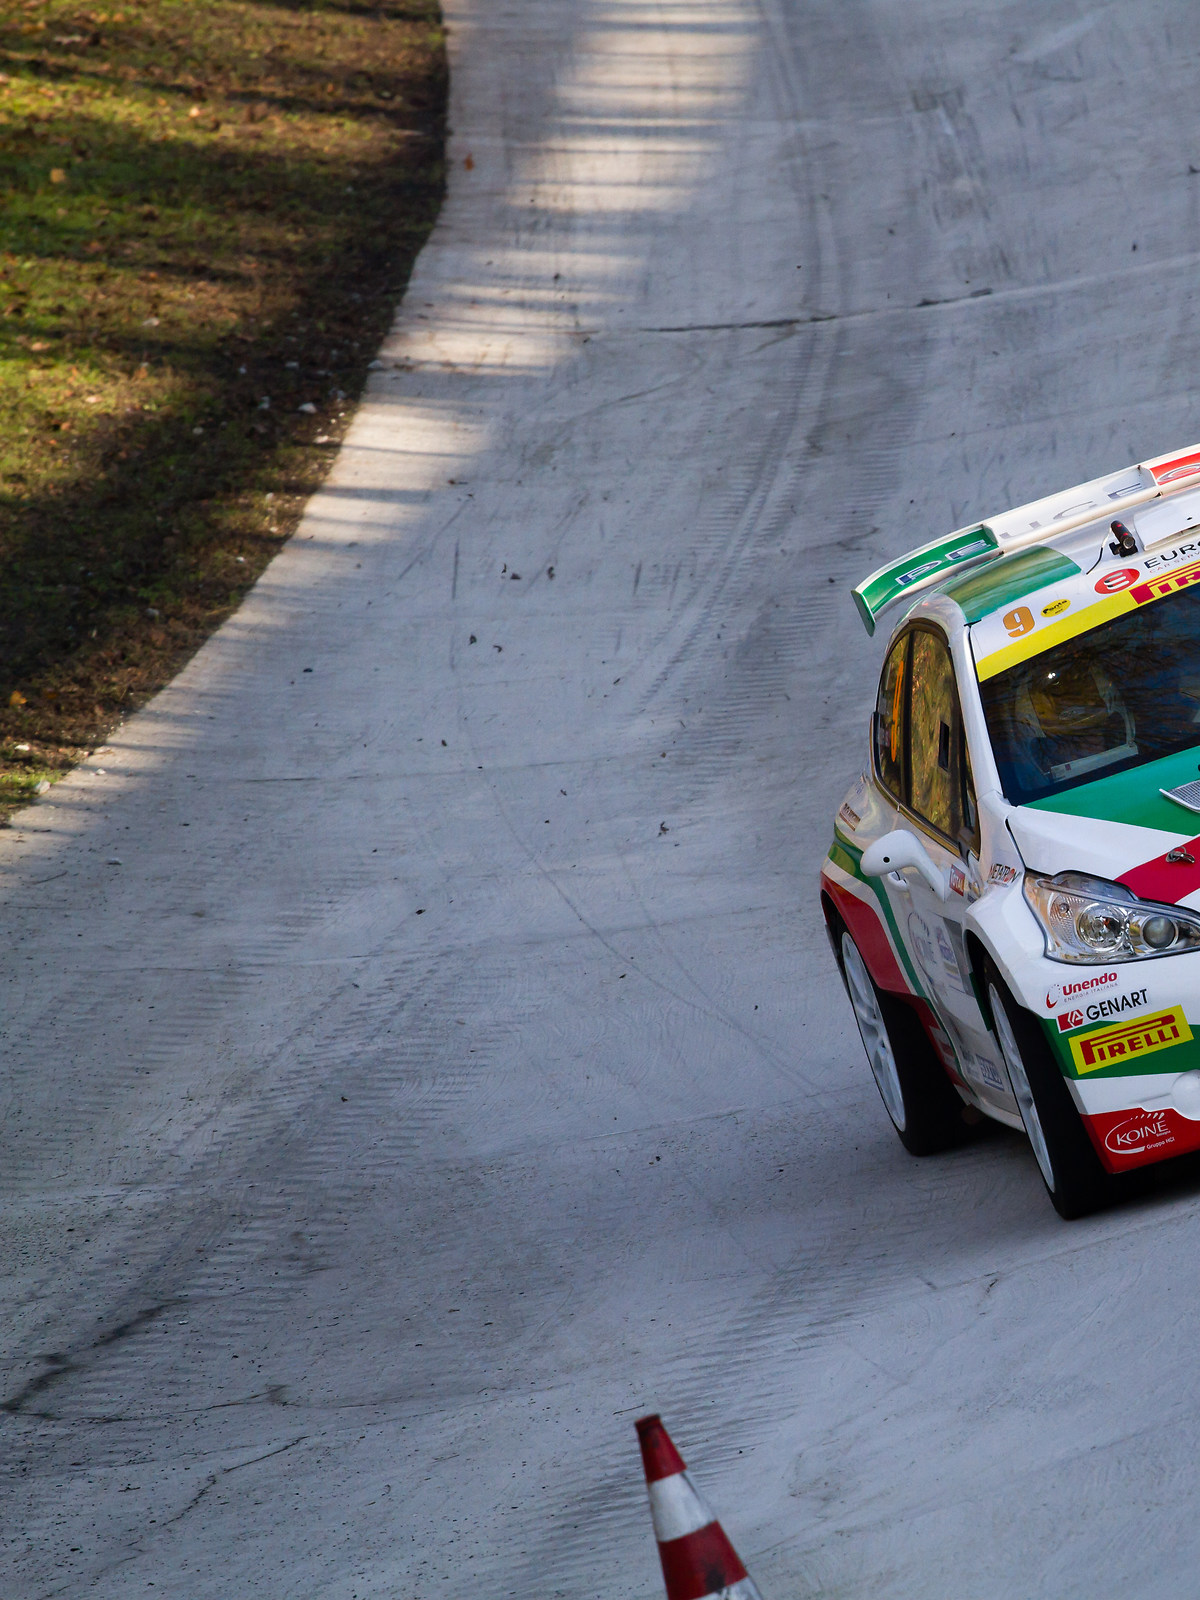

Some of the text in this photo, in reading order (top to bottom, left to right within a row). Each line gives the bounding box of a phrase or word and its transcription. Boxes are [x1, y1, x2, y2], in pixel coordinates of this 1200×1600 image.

[1149, 562, 1171, 574] CAR
[1002, 606, 1035, 638] 9
[1062, 972, 1118, 996] Unendo
[1064, 982, 1119, 1003] ENERGIA ITALIANA
[1086, 988, 1148, 1021] GENART
[1079, 1014, 1180, 1066] PIRELLI
[1116, 1119, 1169, 1146] KOINE
[1146, 1140, 1166, 1150] Gruppo
